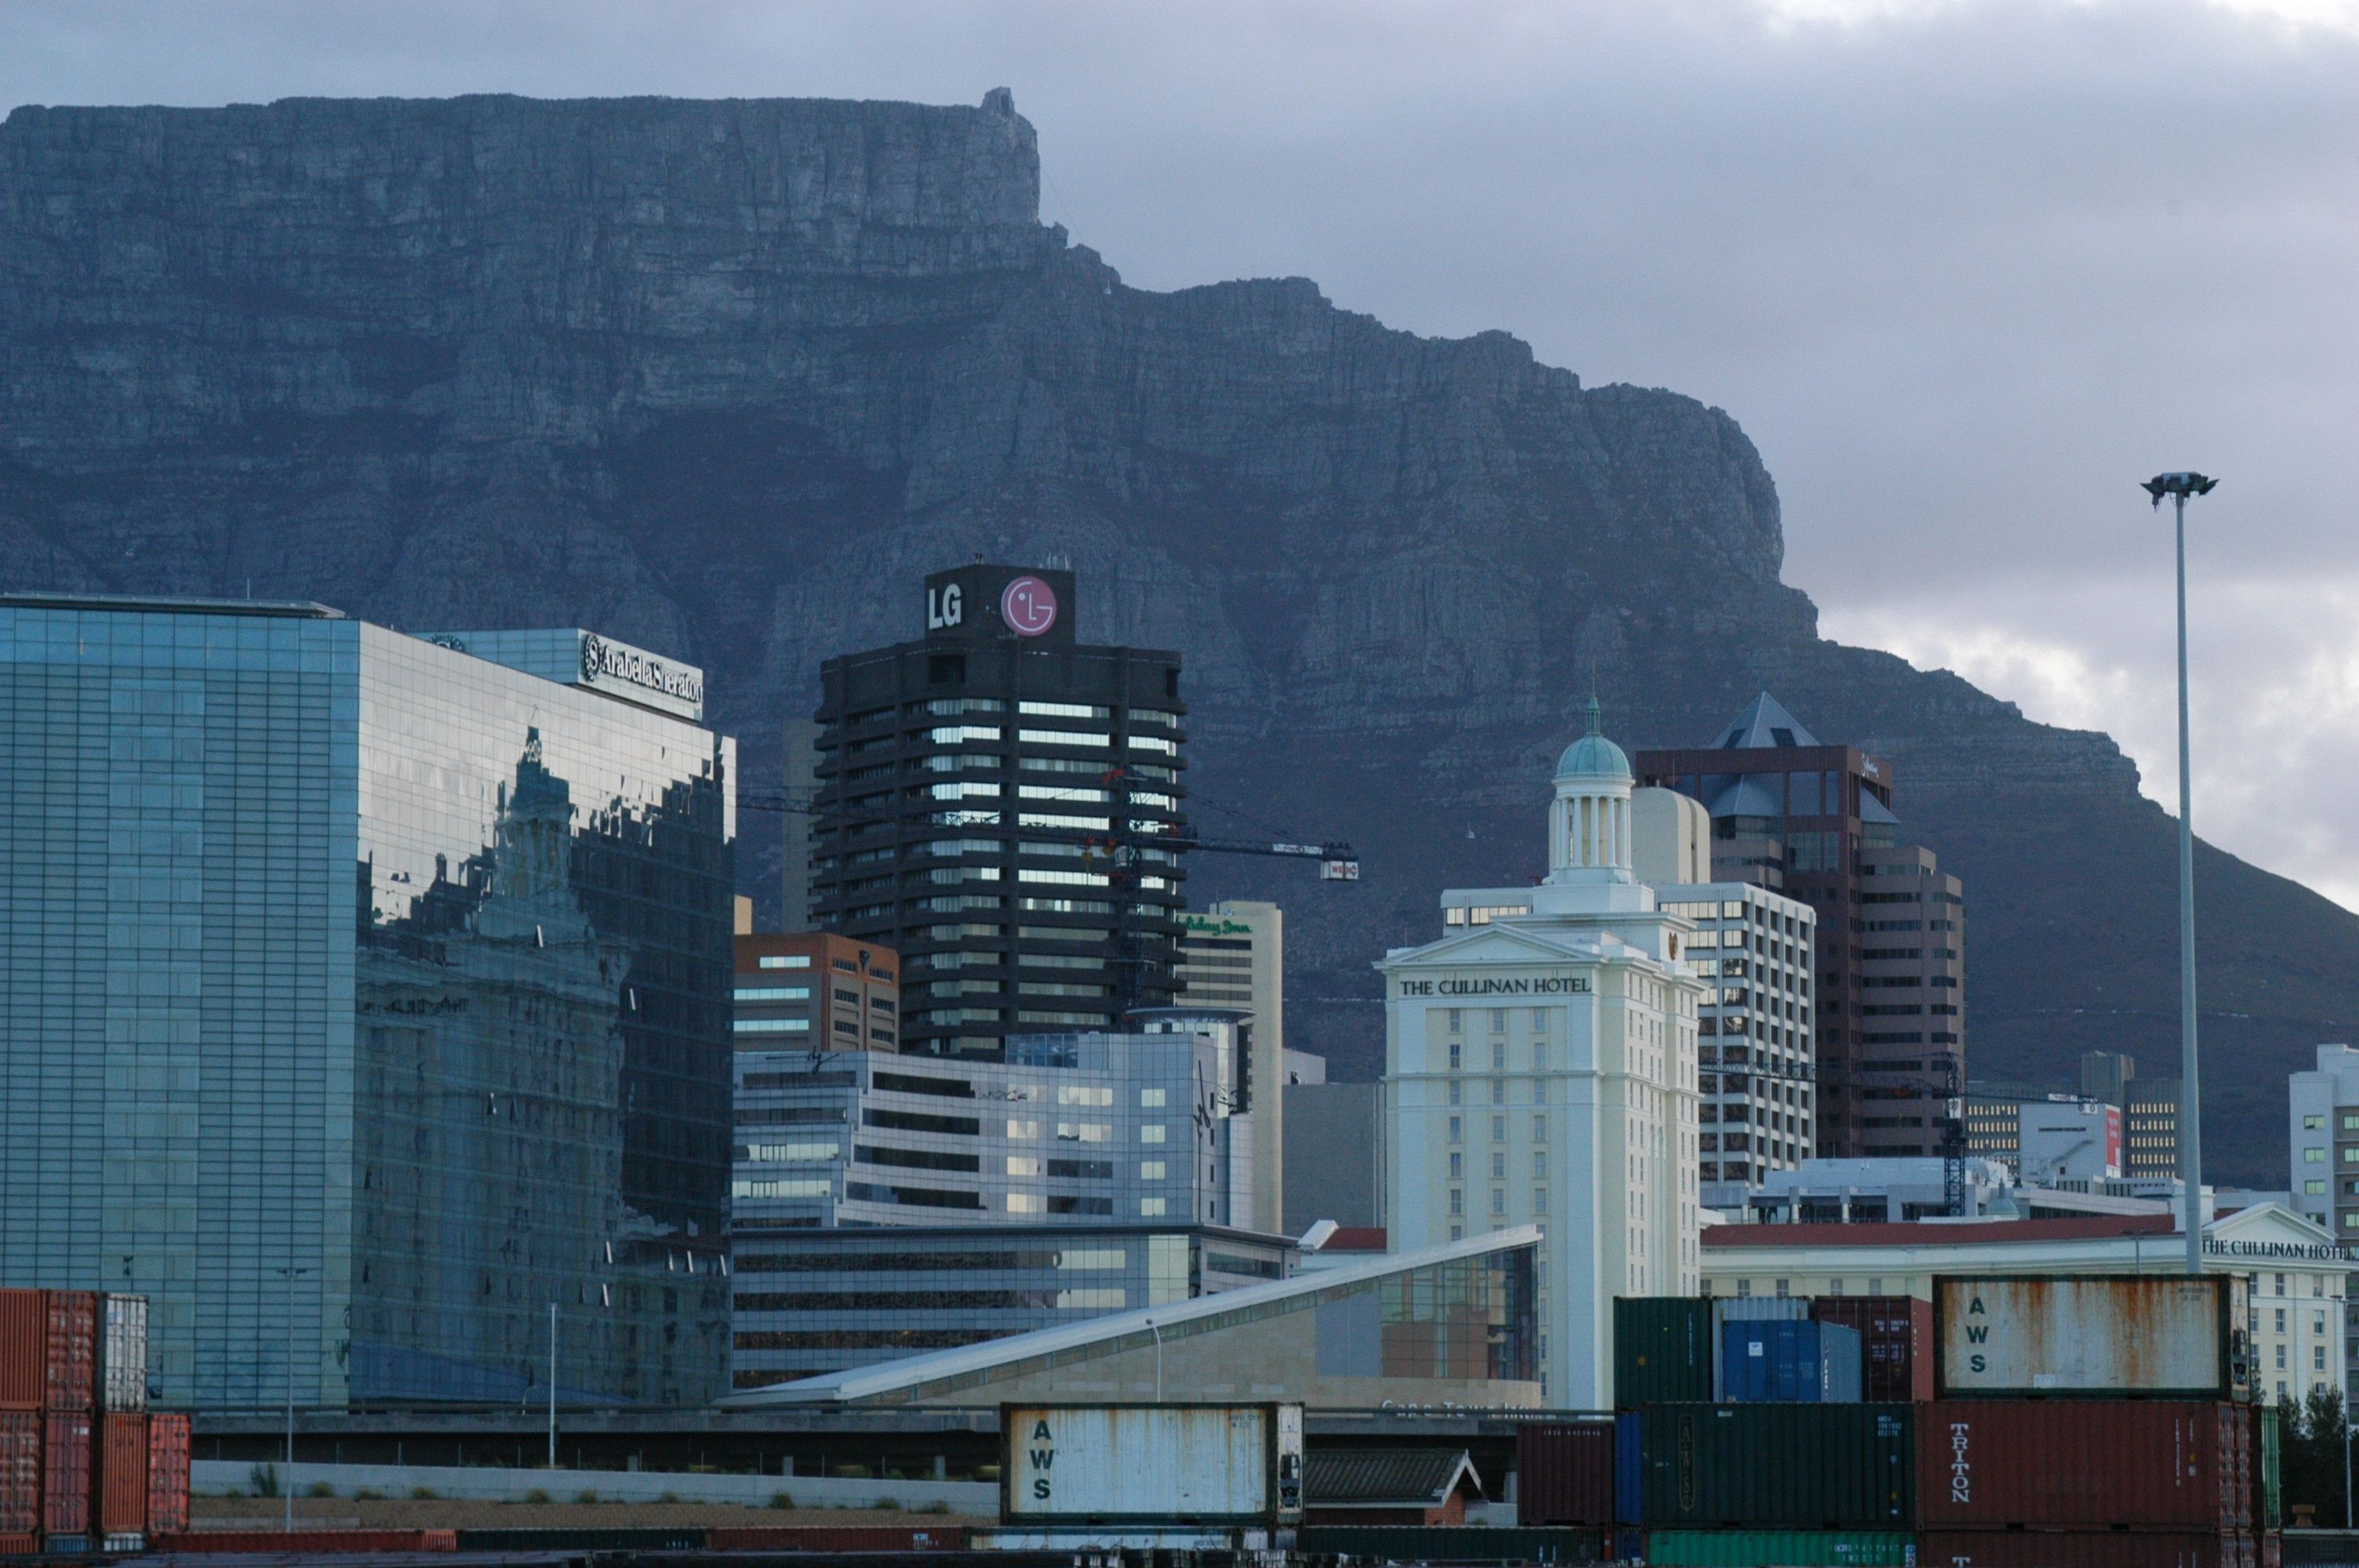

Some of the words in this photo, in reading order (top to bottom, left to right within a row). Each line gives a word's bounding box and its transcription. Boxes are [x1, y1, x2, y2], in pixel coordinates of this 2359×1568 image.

[929, 583, 962, 630] LG
[1185, 914, 1221, 936] liday
[1222, 919, 1252, 935] Inn
[1400, 980, 1434, 995] THE
[1438, 978, 1528, 995] CULLINAN
[1534, 978, 1591, 993] HOTEL
[2201, 1239, 2228, 1256] THE
[2231, 1240, 2305, 1258] CULLINAN
[2308, 1244, 2357, 1261] HOTEL
[1965, 1296, 1989, 1373] AWS
[1029, 1420, 1055, 1500] AWS
[1950, 1423, 1970, 1503] TRITON
